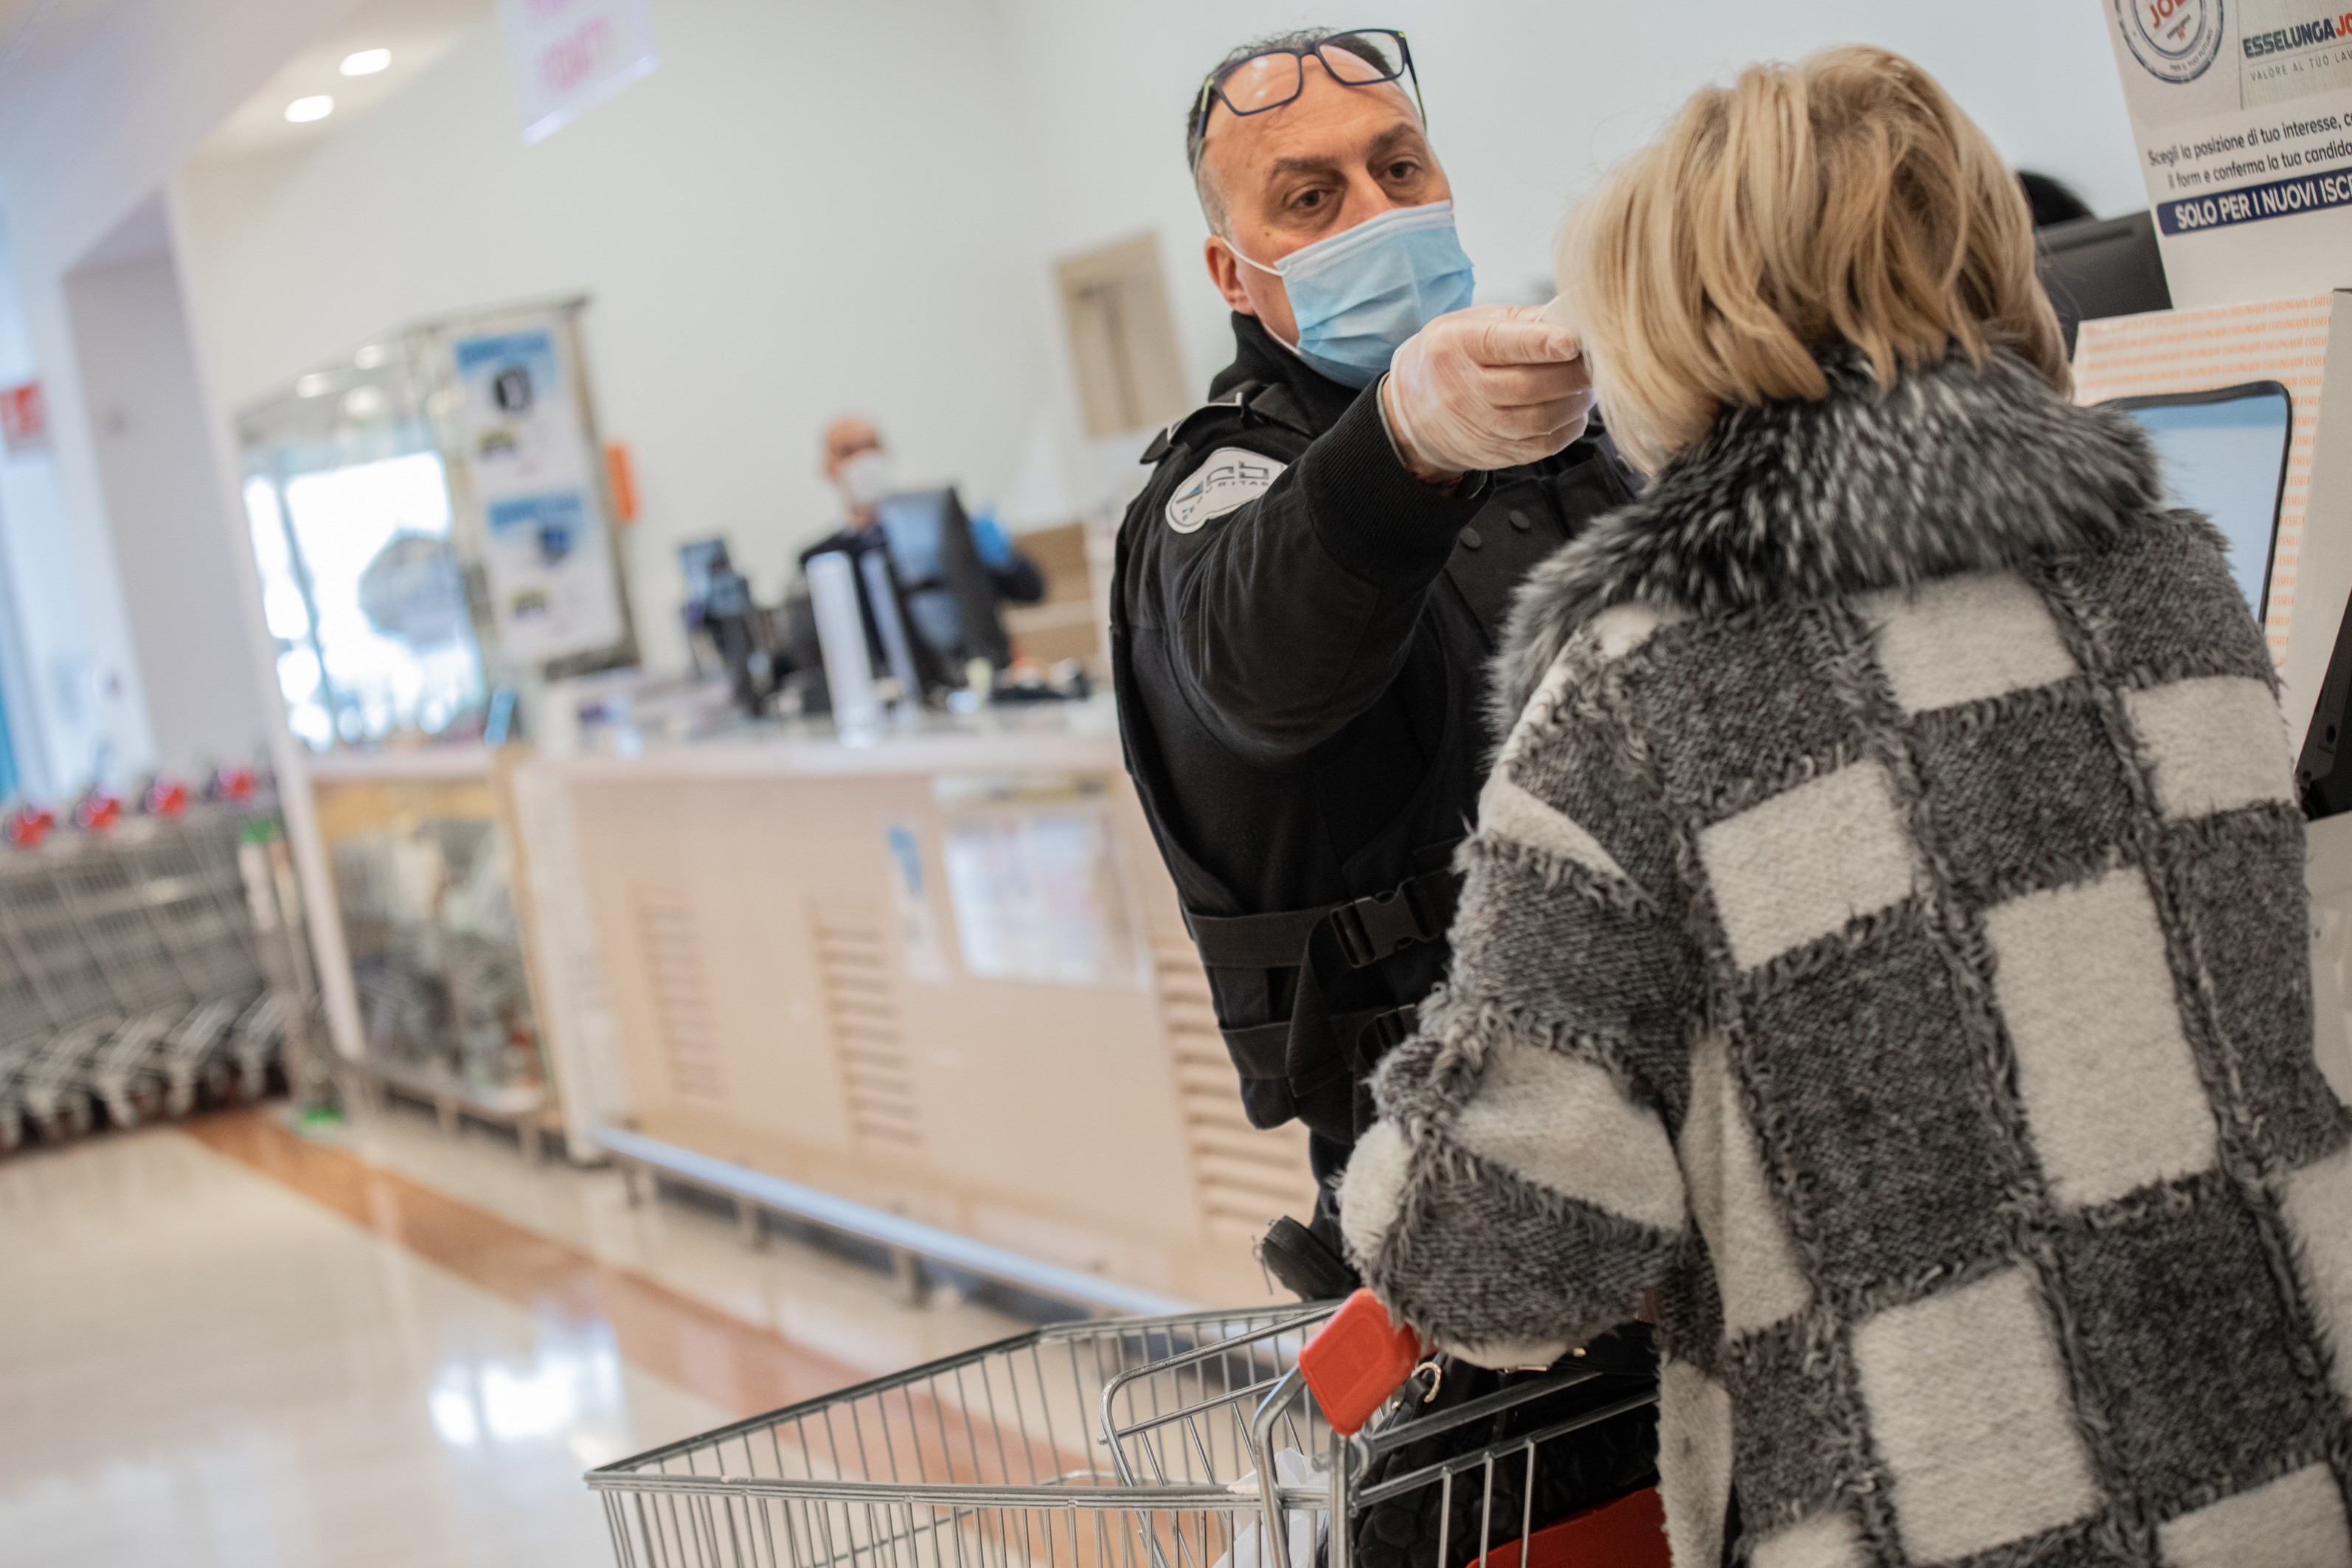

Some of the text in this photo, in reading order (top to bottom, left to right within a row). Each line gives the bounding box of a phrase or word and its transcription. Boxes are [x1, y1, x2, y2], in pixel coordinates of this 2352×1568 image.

[2250, 65, 2288, 83] VALORE
[2293, 61, 2305, 72] AL
[2309, 55, 2330, 69] TUO
[2147, 143, 2179, 167] Scegli
[2179, 142, 2192, 160] la
[2193, 134, 2245, 162] posizione
[2247, 130, 2258, 147] di
[2260, 127, 2280, 144] tuo
[2282, 115, 2342, 140] interesse,
[2176, 170, 2202, 188] form
[2203, 170, 2211, 184] e
[2213, 159, 2266, 181] conferma
[2266, 153, 2280, 171] la
[2280, 152, 2303, 168] tua
[2174, 198, 2218, 230] SOLO
[2219, 192, 2253, 222] PER
[2252, 191, 2261, 216] I
[2261, 180, 2319, 215] NUOVI
